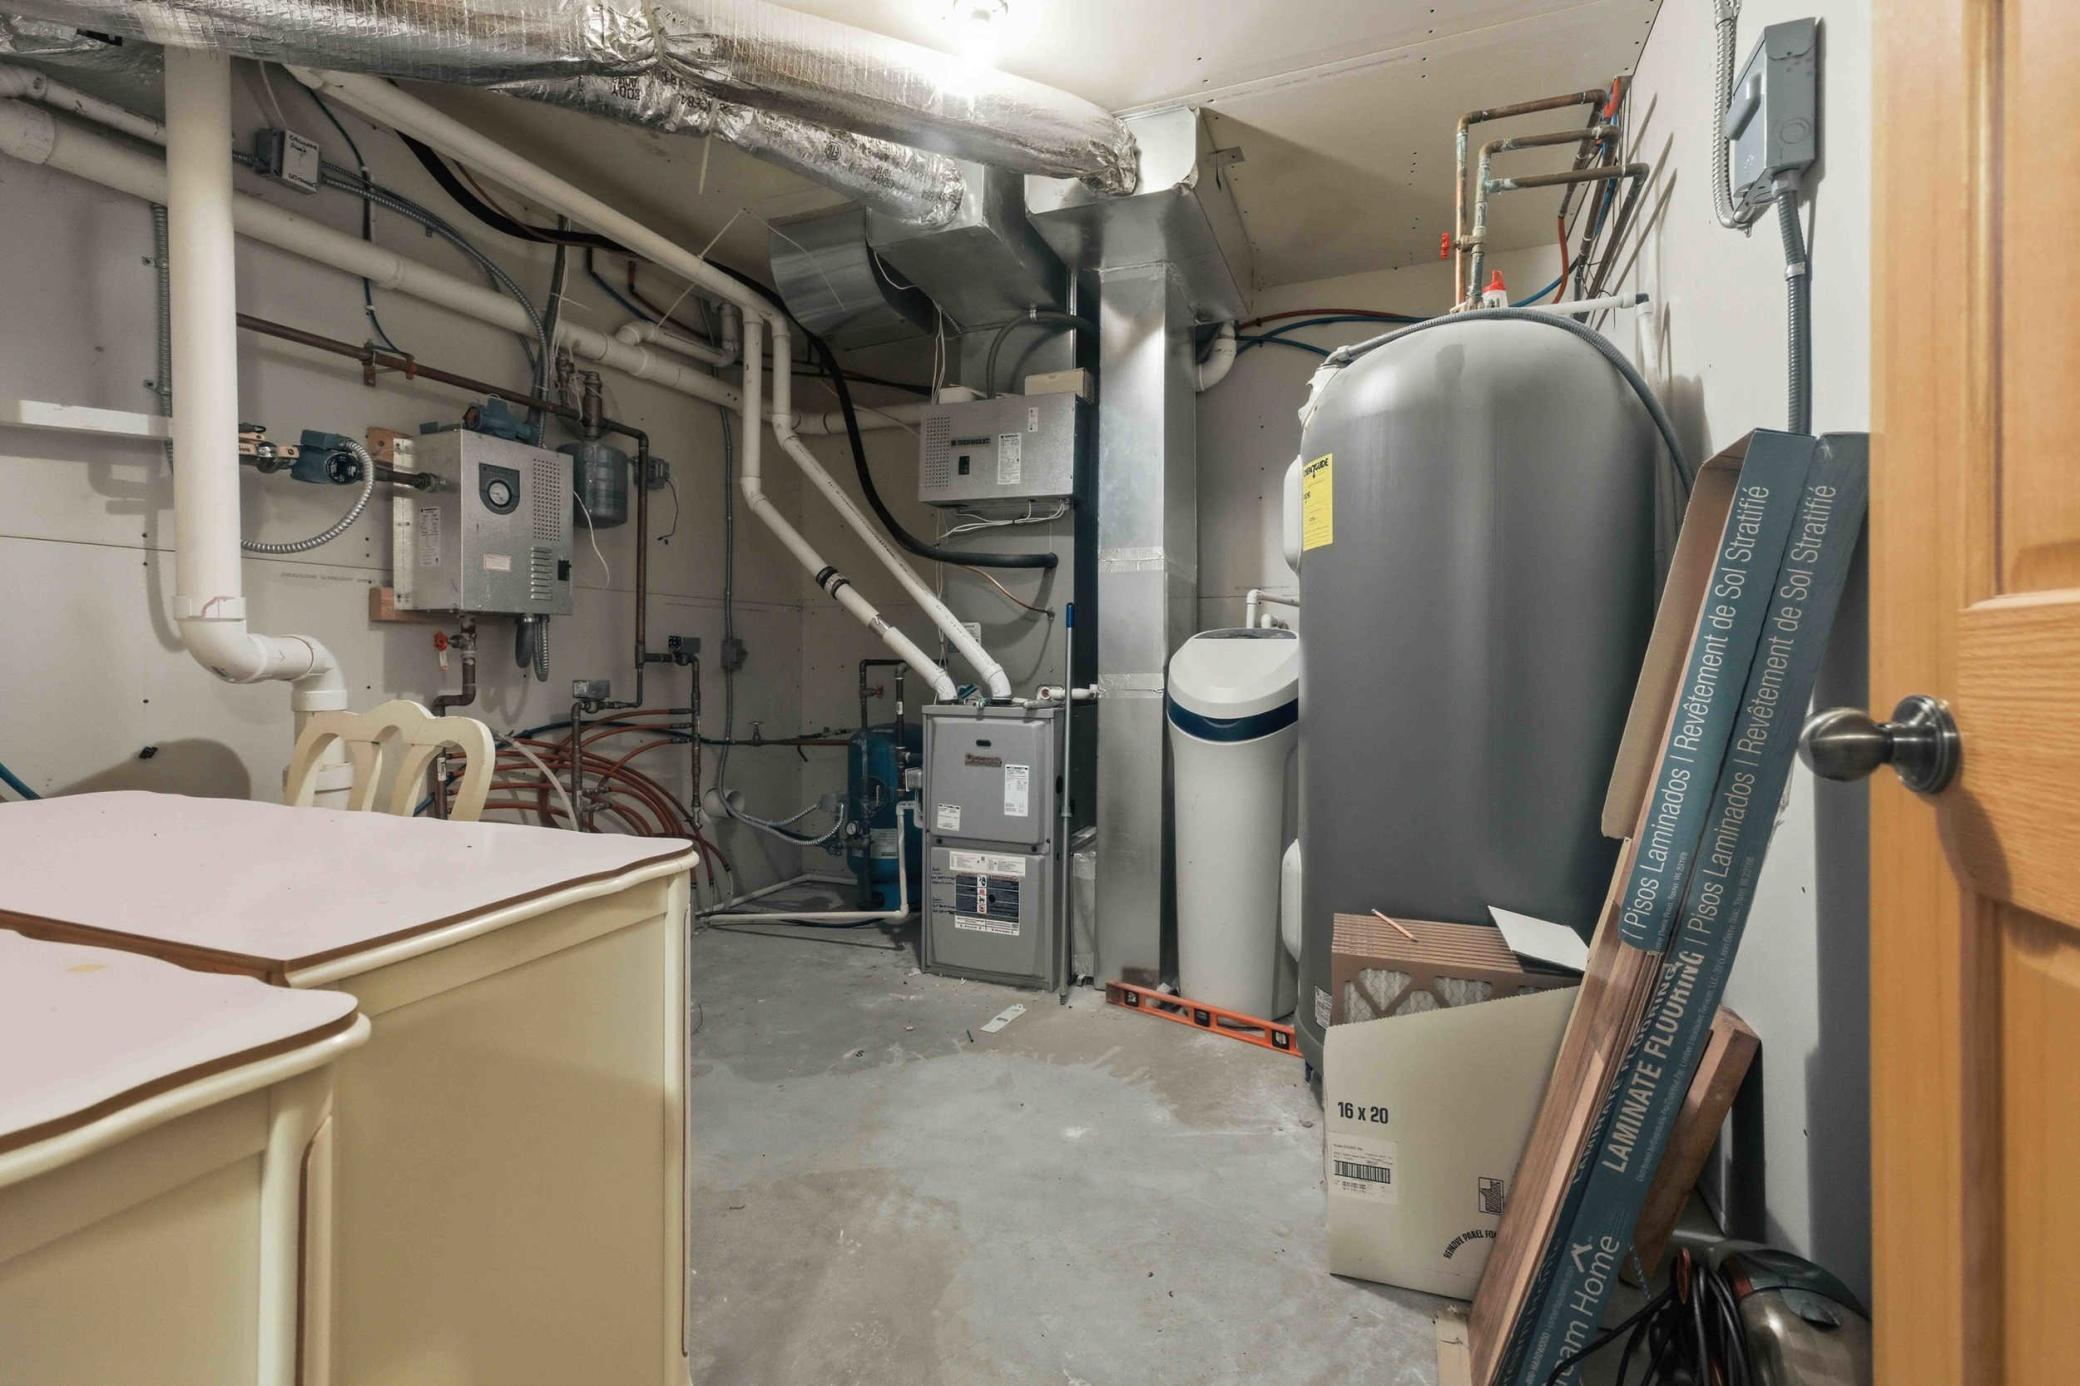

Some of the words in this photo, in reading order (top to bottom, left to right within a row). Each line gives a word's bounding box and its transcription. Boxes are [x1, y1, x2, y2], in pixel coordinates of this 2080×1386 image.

[1725, 486, 1770, 562] Stratifié
[1791, 484, 1837, 564] Stratifié
[1708, 604, 1737, 630] de
[1714, 567, 1747, 599] Sol
[1773, 606, 1802, 632] de
[1780, 568, 1814, 601] Sol
[1673, 634, 1729, 751] Revêtement
[1737, 635, 1795, 755] Revêtement
[1639, 768, 1691, 873] Laminados
[1703, 772, 1756, 878] Laminados
[1624, 877, 1659, 929] Pisos
[1687, 881, 1724, 934] Pisos
[1338, 1101, 1354, 1119] 16
[1358, 1108, 1366, 1121] x
[1370, 1106, 1389, 1124] 20
[1601, 1060, 1663, 1173] LAMINATE
[1570, 1235, 1620, 1317] Home
